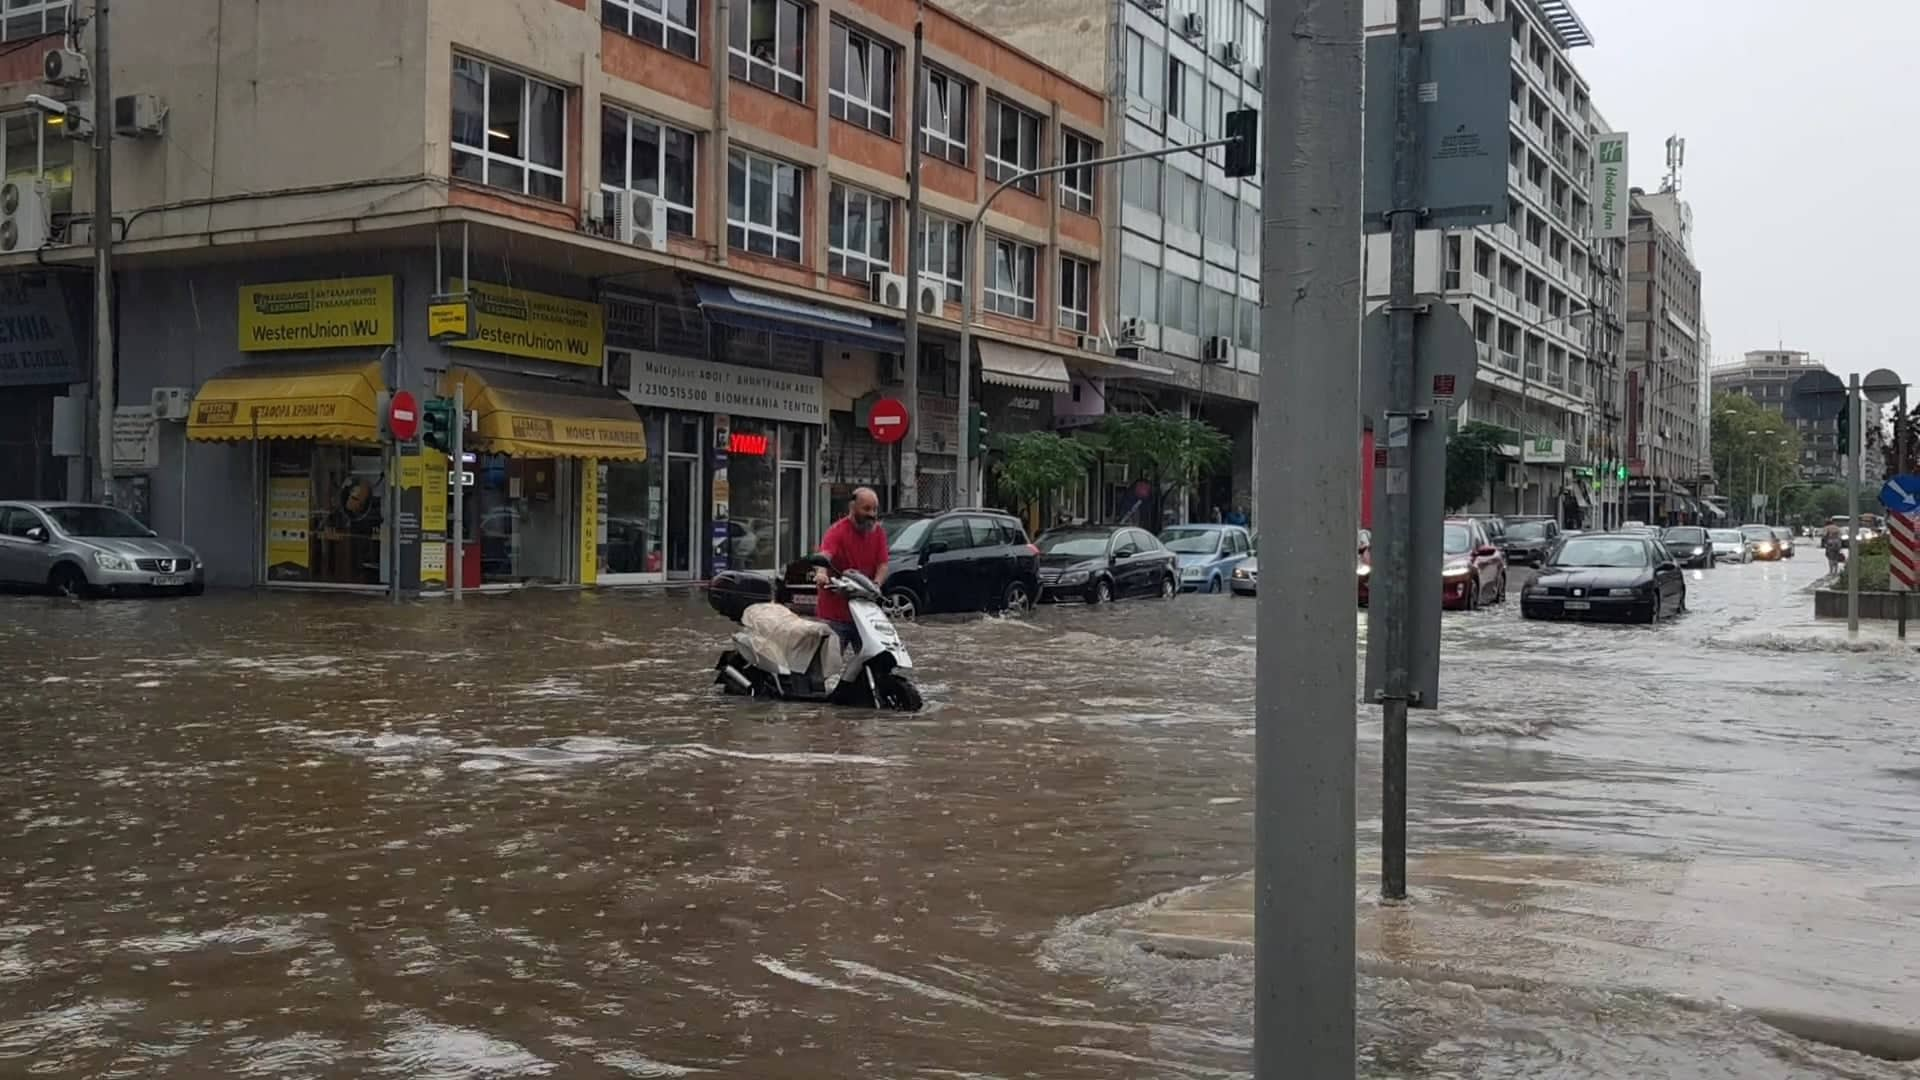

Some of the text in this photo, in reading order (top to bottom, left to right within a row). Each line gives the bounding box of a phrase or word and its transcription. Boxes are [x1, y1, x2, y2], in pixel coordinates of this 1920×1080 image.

[1602, 167, 1618, 230] Holiday Inn
[353, 320, 379, 336] WU
[567, 337, 590, 357] WU
[715, 392, 779, 409] ΒΙΟΜΗΧΑΝΙΑ
[783, 399, 819, 414] ΤΕΝΤΩΝ
[565, 425, 595, 441] MONEY
